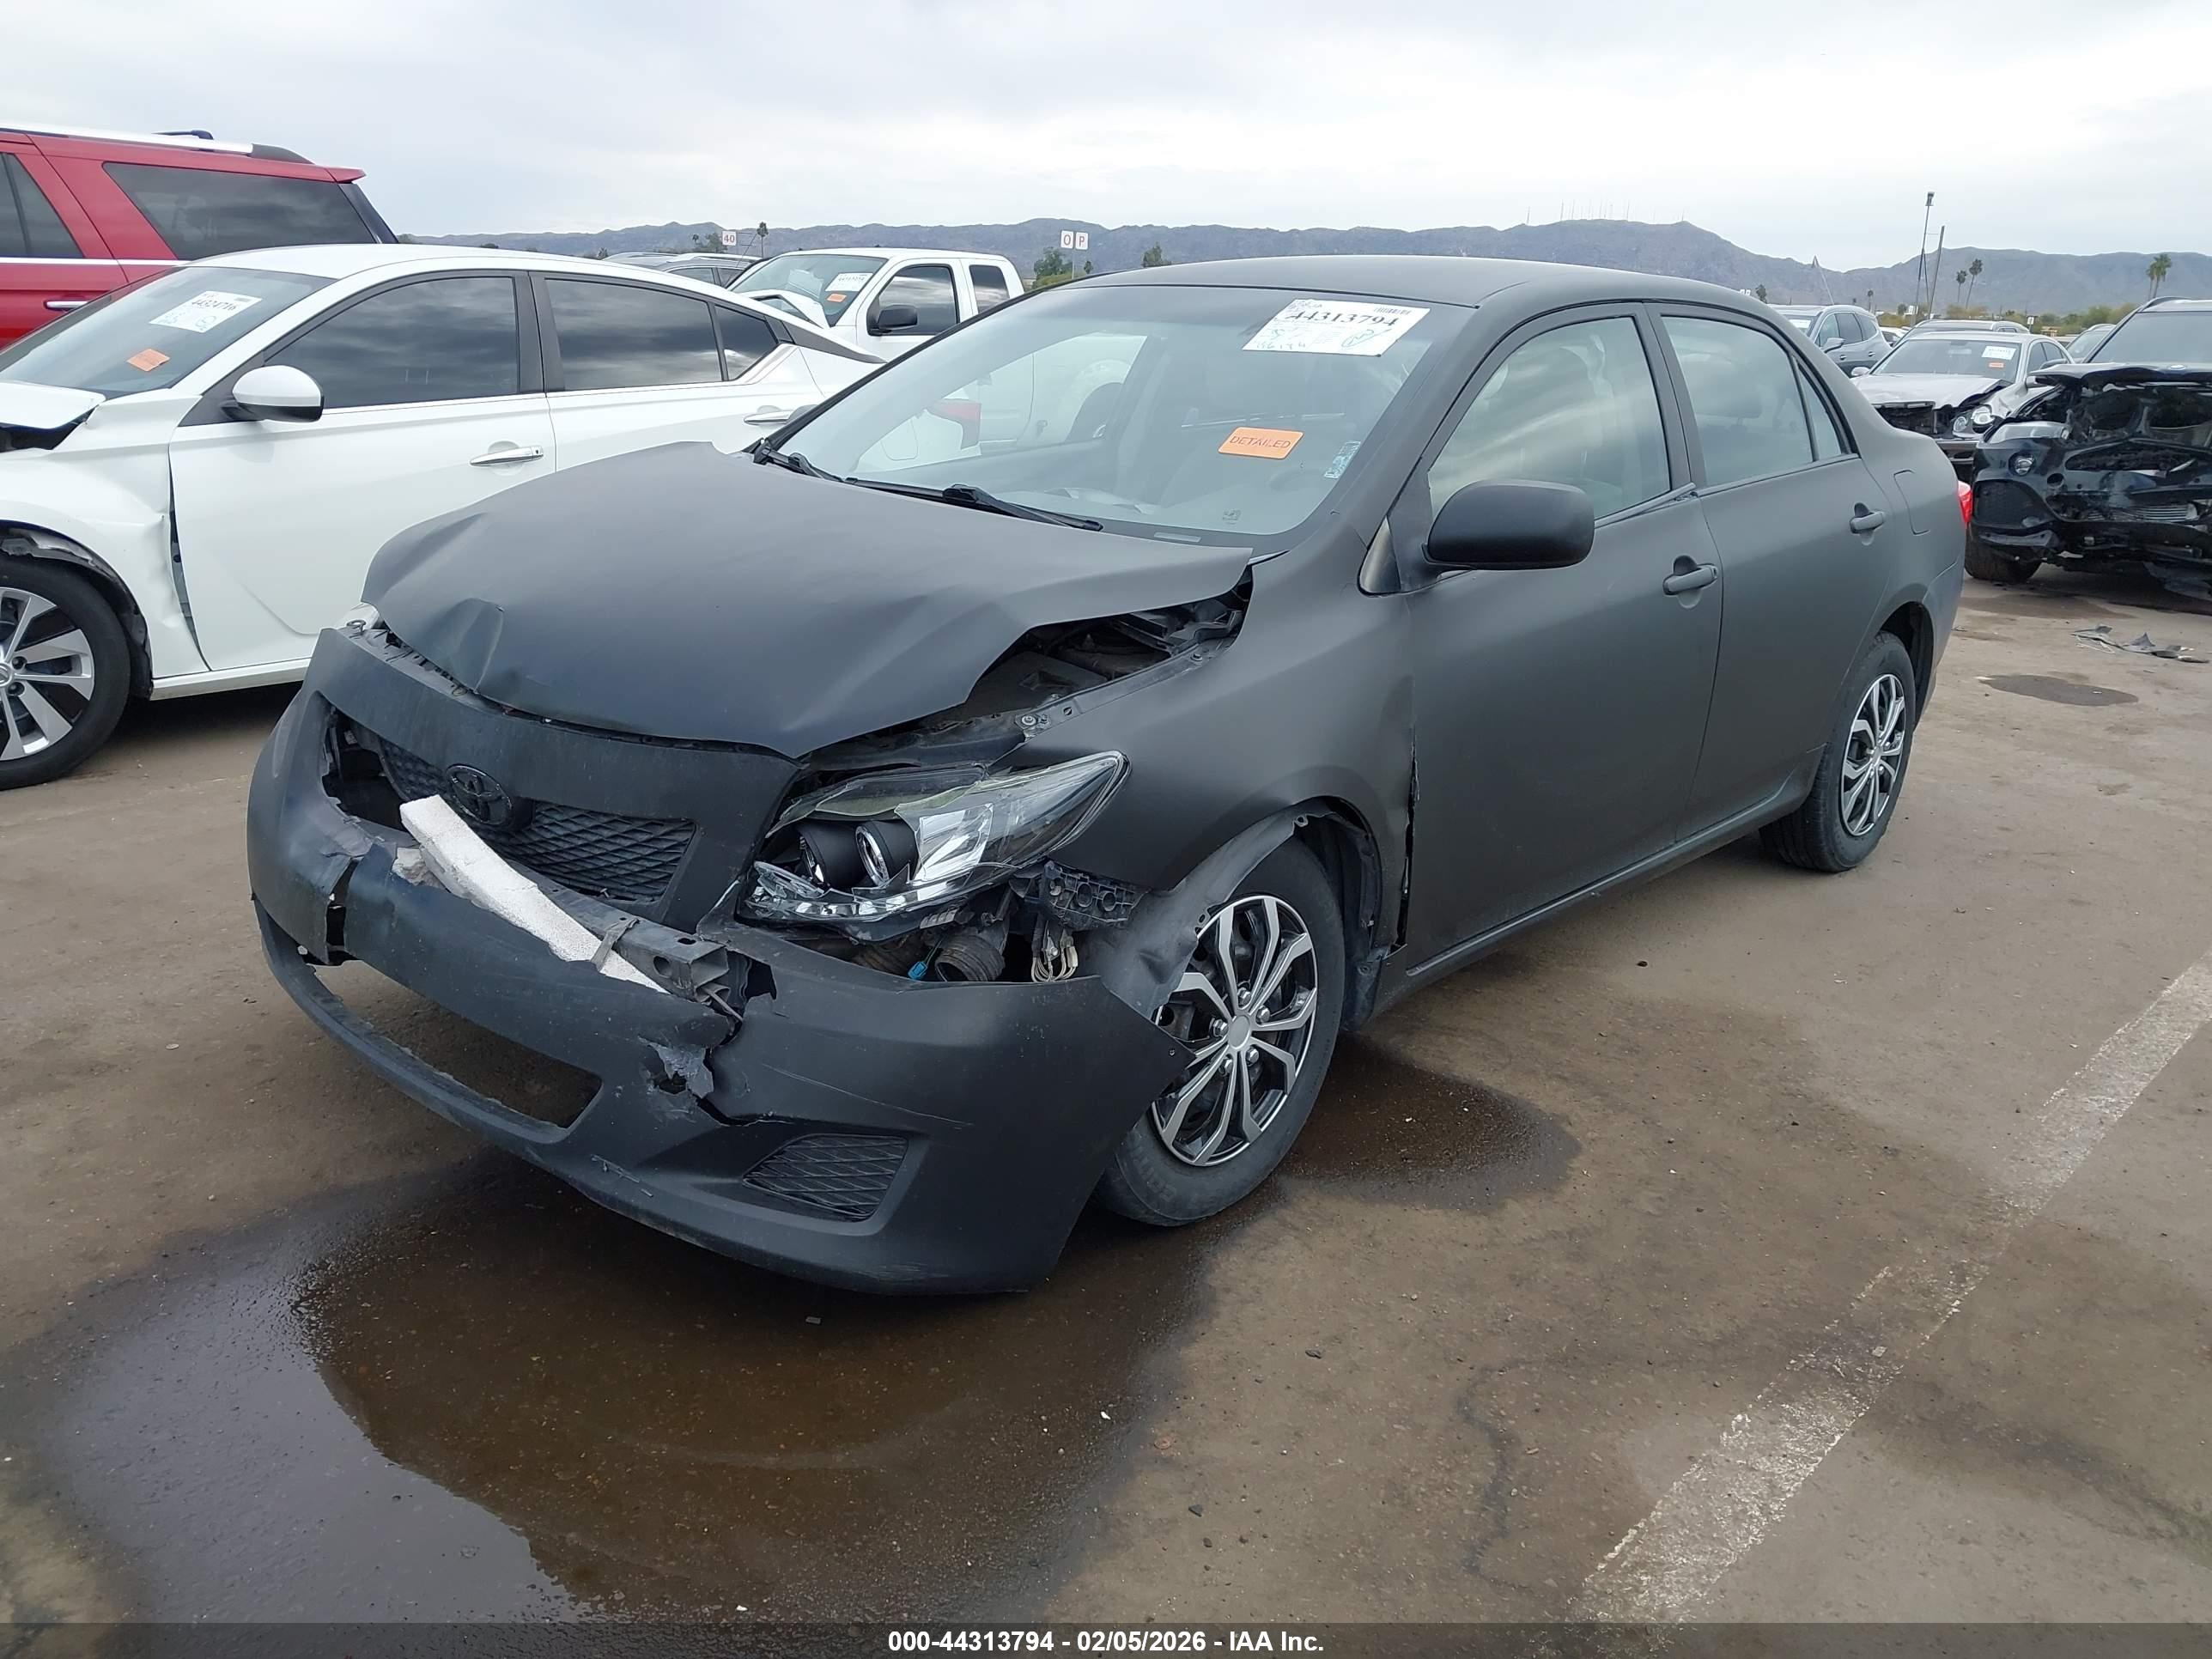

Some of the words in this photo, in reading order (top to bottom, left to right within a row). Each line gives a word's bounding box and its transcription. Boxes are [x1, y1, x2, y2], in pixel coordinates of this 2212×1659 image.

[723, 234, 735, 243] 40
[1079, 235, 1085, 247] P
[1285, 310, 1400, 327] 44313794
[1229, 434, 1291, 449] DETAILED
